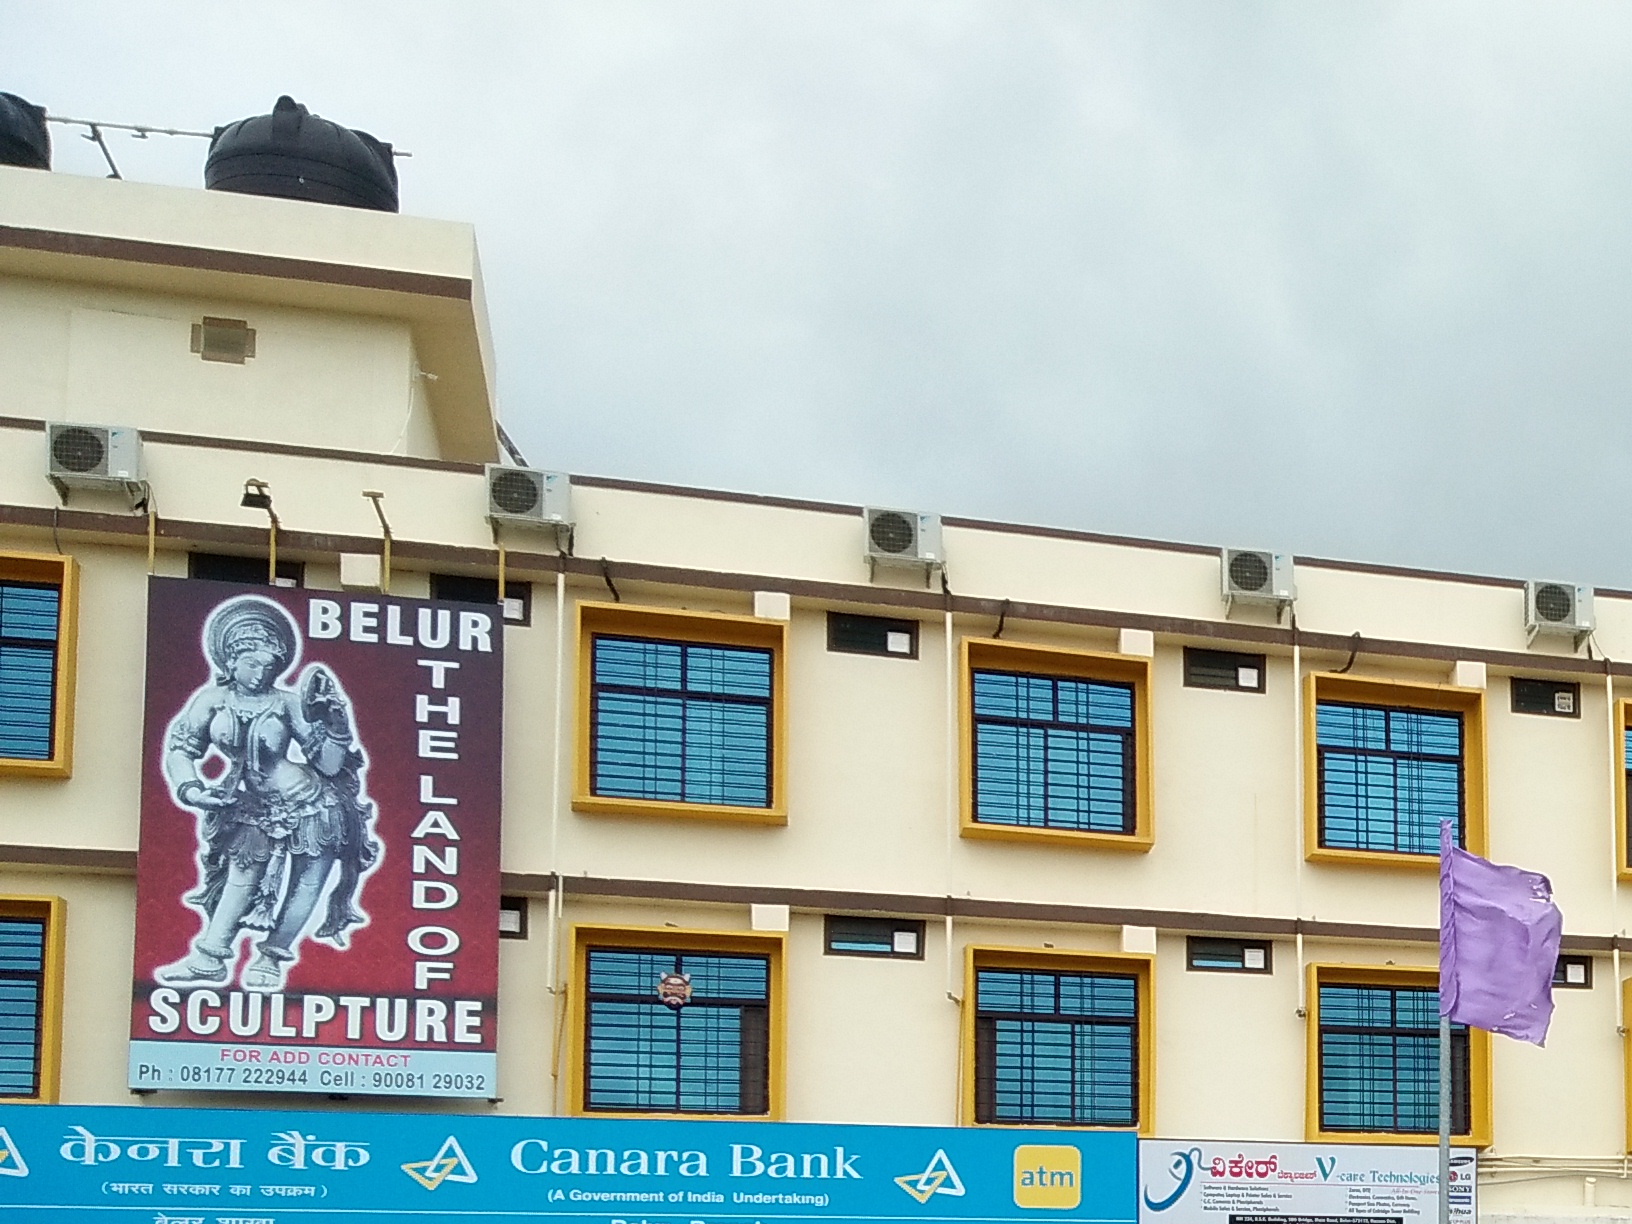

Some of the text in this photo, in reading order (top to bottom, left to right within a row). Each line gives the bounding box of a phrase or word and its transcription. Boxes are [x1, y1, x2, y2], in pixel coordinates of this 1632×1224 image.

[308, 597, 493, 653] BELUR
[415, 658, 461, 761] THE
[410, 774, 461, 911] LAND
[406, 925, 461, 990] OF
[148, 986, 484, 1044] SCULPTURE
[179, 1064, 235, 1085] 08177
[242, 1066, 308, 1086] 222944
[372, 1071, 426, 1090] 90081
[432, 1072, 485, 1091] 29032
[220, 1047, 411, 1068] FOR ADD CONTACT
[59, 1125, 371, 1171] केनरा बैंक
[510, 1139, 864, 1179] Canara Bank
[101, 1181, 154, 1196] (भारत
[163, 1183, 220, 1197] सरकार
[230, 1184, 252, 1197] का
[1021, 1166, 1074, 1188] atm
[1370, 1170, 1440, 1186] Technologies
[548, 1189, 830, 1207] (A Government of India Undertaking)
